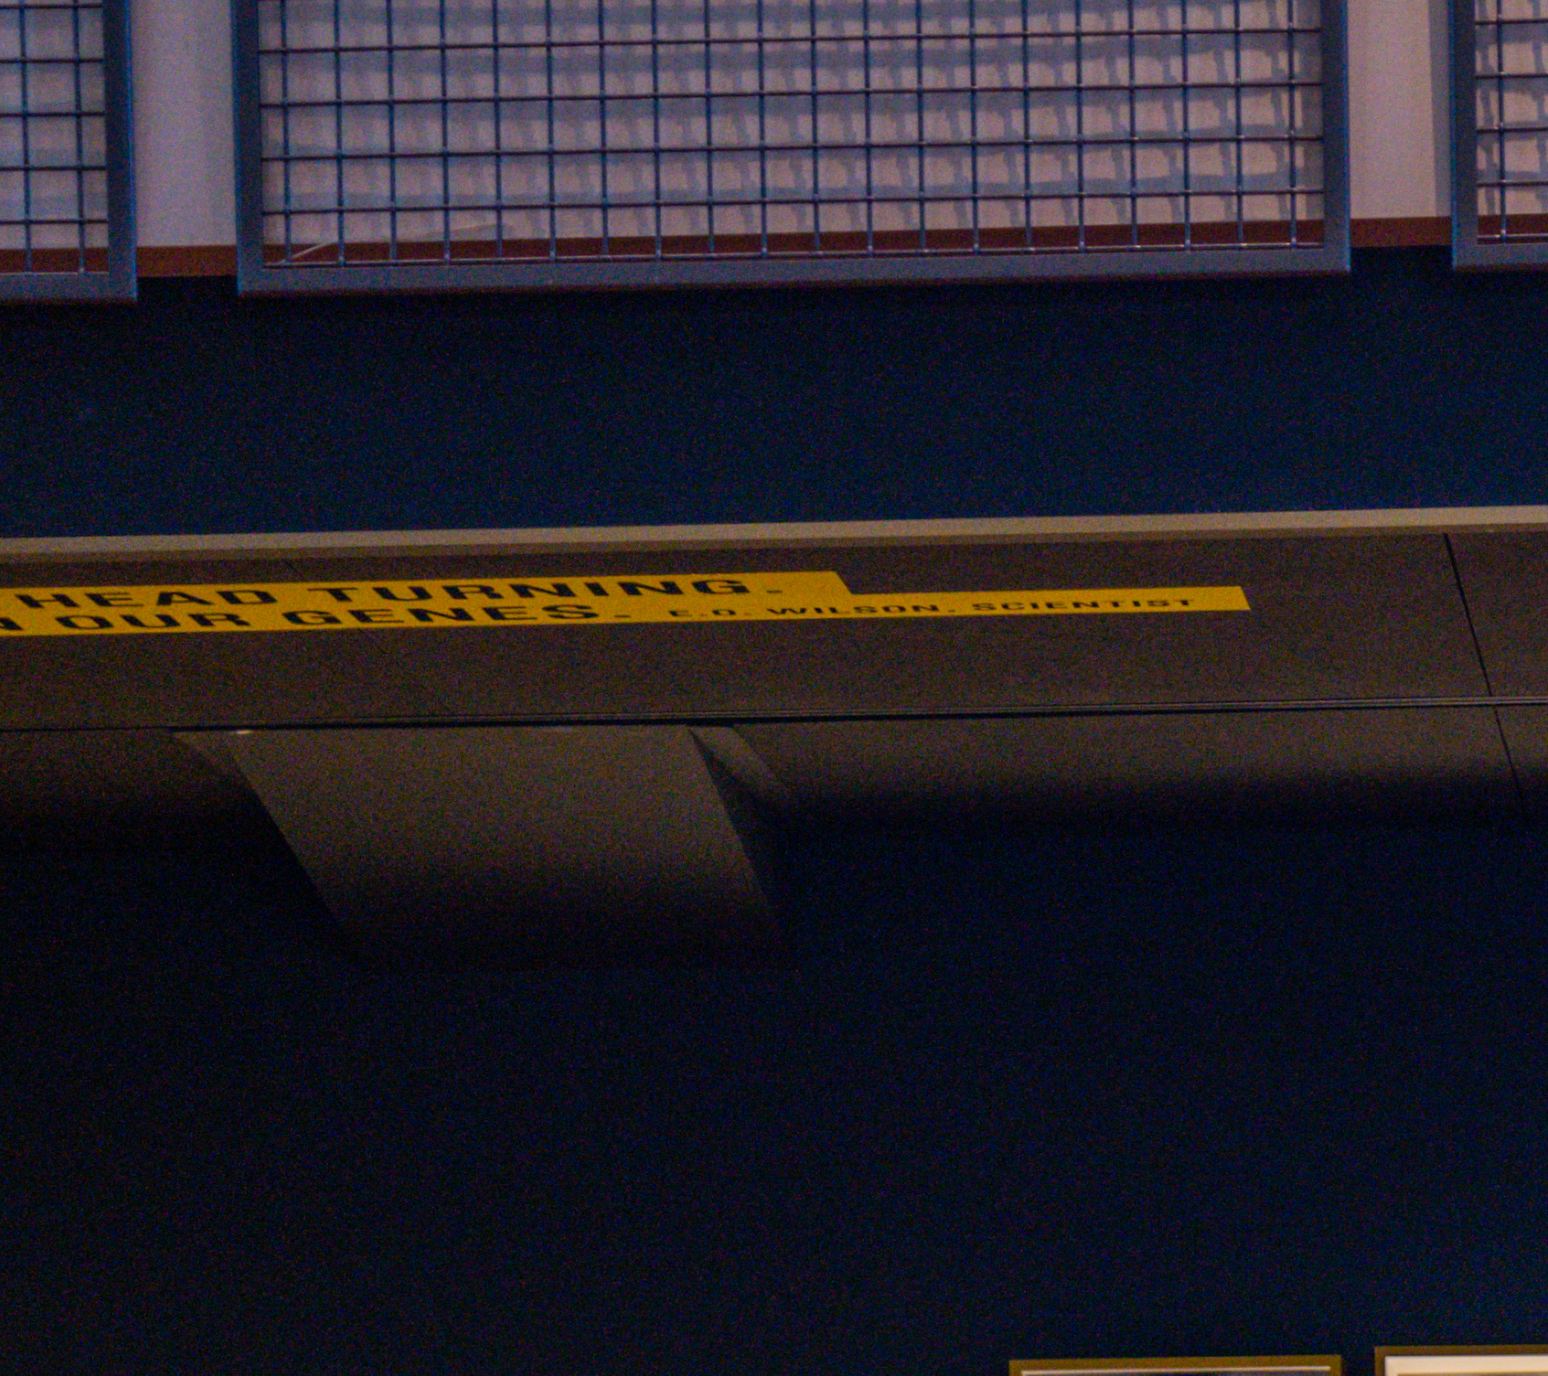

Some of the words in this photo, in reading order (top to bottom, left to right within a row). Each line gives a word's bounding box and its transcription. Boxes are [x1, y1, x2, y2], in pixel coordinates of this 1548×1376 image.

[13, 589, 279, 610] HEAD
[307, 579, 783, 604] TURNING.
[56, 612, 254, 631] OUR
[281, 604, 630, 626] GENES.
[969, 597, 1195, 612] SCIENTIST
